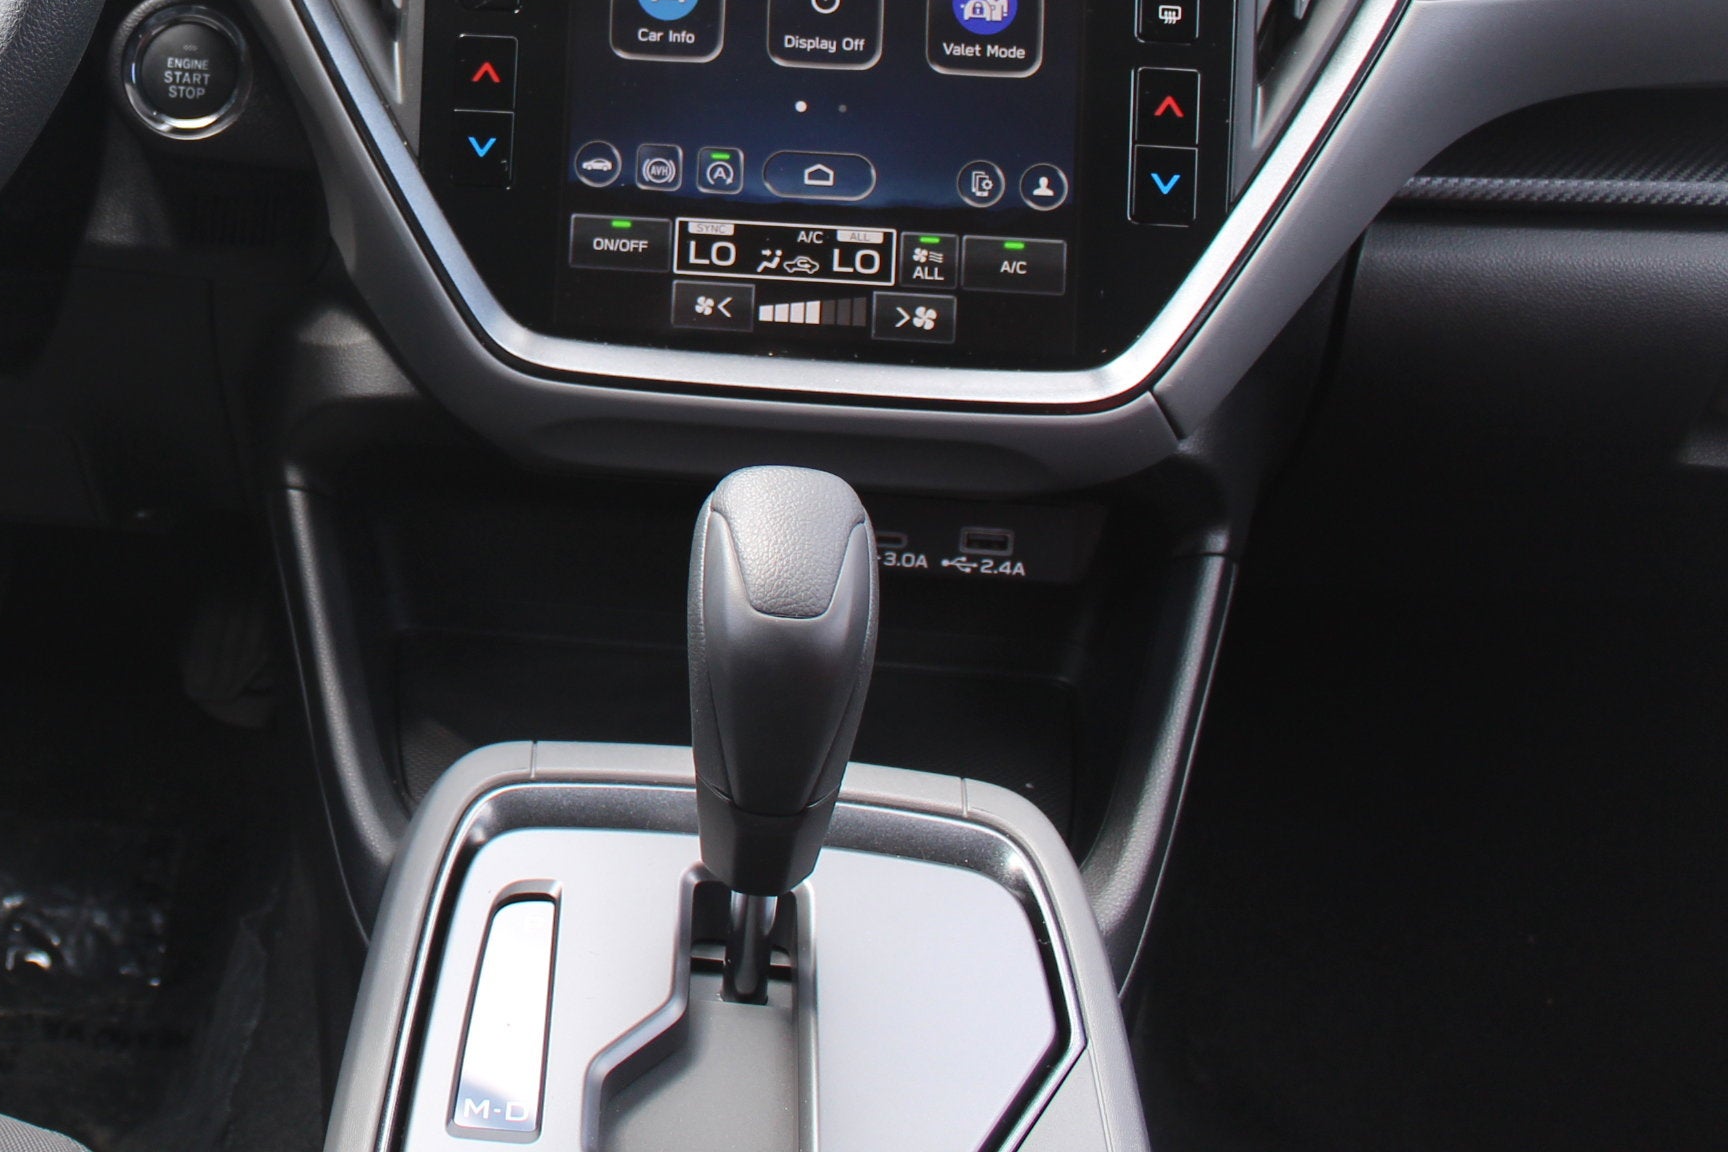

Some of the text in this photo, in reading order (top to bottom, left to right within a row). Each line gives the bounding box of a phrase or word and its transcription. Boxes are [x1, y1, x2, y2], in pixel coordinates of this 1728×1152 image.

[638, 29, 696, 44] Car Info
[784, 36, 865, 54] Display Off
[943, 43, 1026, 60] Valet Mode
[167, 57, 209, 70] ENGINE
[164, 70, 210, 86] START
[168, 85, 205, 99] STOP
[650, 166, 670, 176] AVH
[696, 224, 728, 234] SYNC
[797, 231, 824, 244] A/C
[849, 232, 871, 242] ALL
[592, 238, 649, 253] ON/OFF
[689, 241, 736, 266] LO
[833, 248, 880, 274] LO
[912, 266, 945, 281] ALL
[1000, 260, 1027, 275] A/C
[883, 551, 928, 568] 3.0A
[980, 559, 1026, 576] 2.4A
